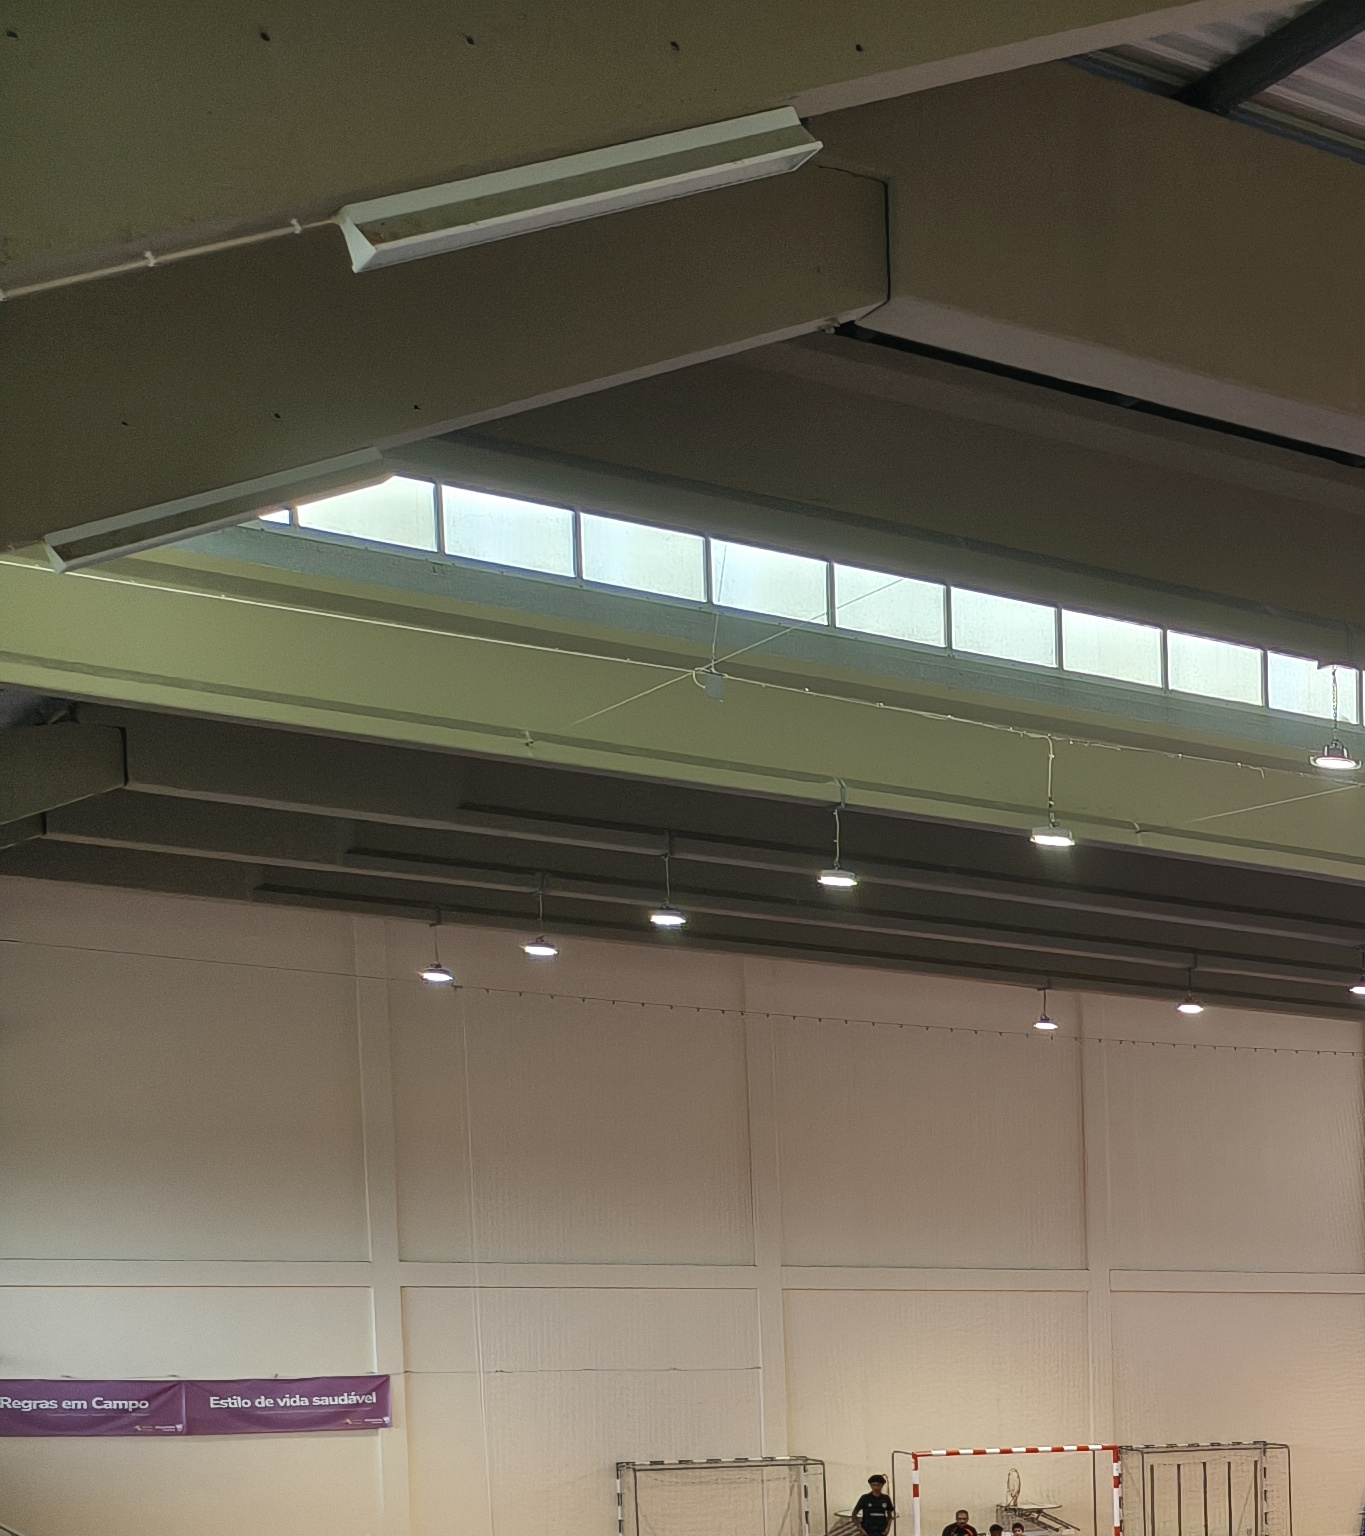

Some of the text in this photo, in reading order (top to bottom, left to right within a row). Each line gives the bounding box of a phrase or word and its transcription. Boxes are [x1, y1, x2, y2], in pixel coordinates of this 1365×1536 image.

[0, 1396, 150, 1412] Regras em Campo
[209, 1390, 377, 1410] Estilo de vida saudável
